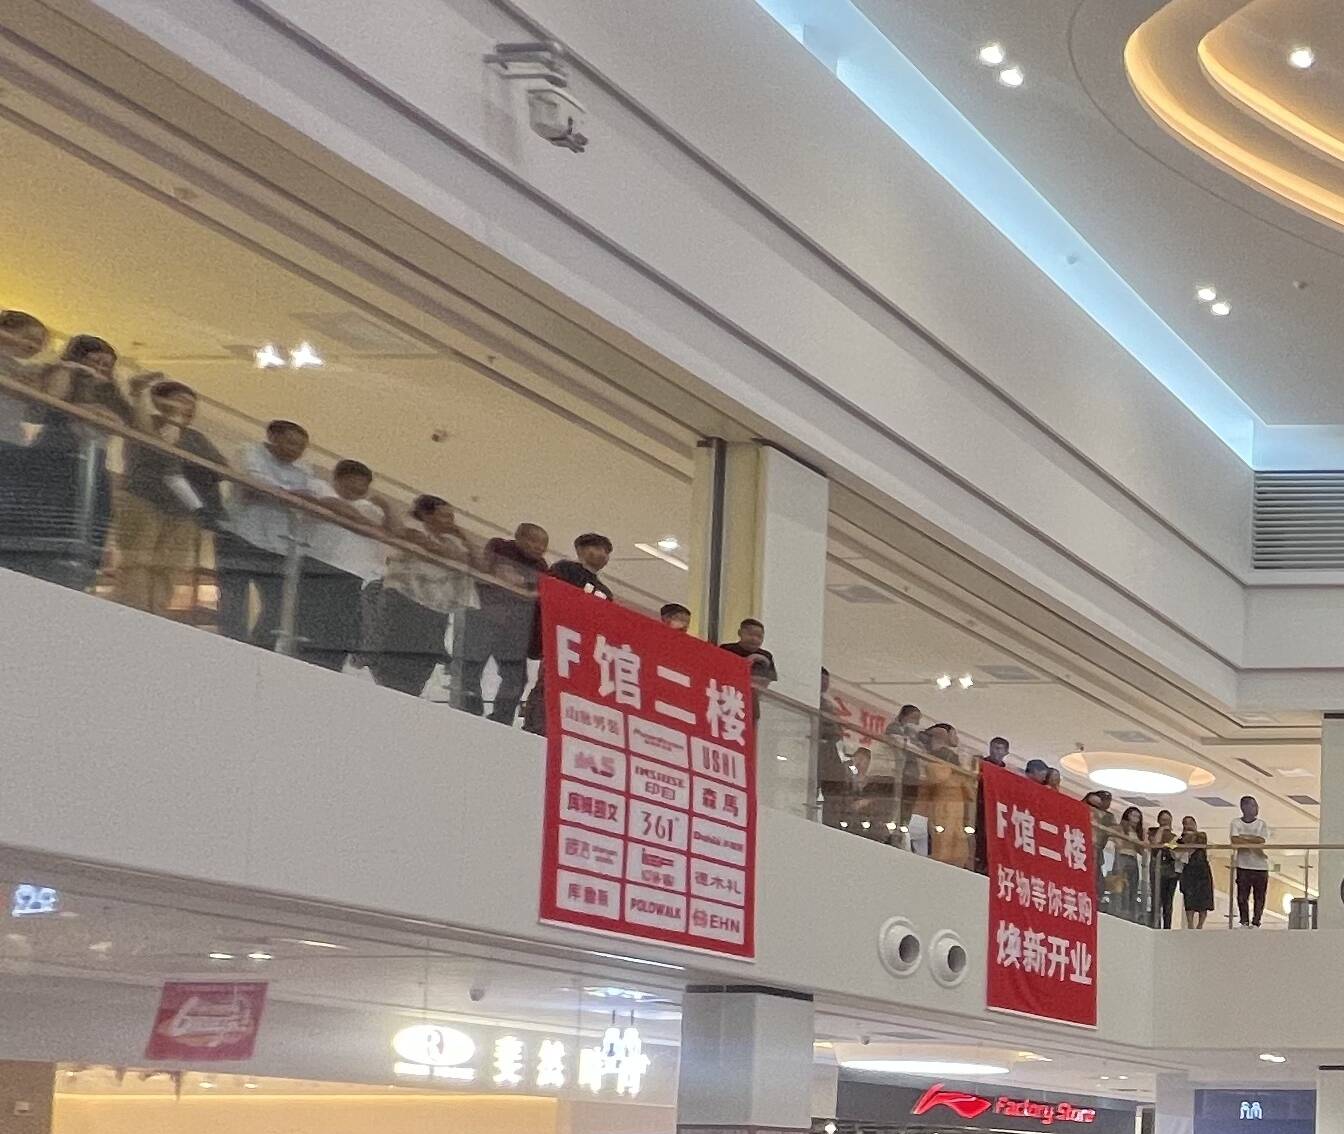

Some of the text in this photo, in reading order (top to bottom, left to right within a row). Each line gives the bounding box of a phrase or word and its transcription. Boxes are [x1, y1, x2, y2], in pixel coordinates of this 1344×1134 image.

[555, 624, 747, 747] F馆二楼
[996, 801, 1087, 872] F馆二楼
[709, 914, 741, 933] EHN
[997, 920, 1093, 985] 焕新开业
[995, 1096, 1096, 1125] Factory Store
